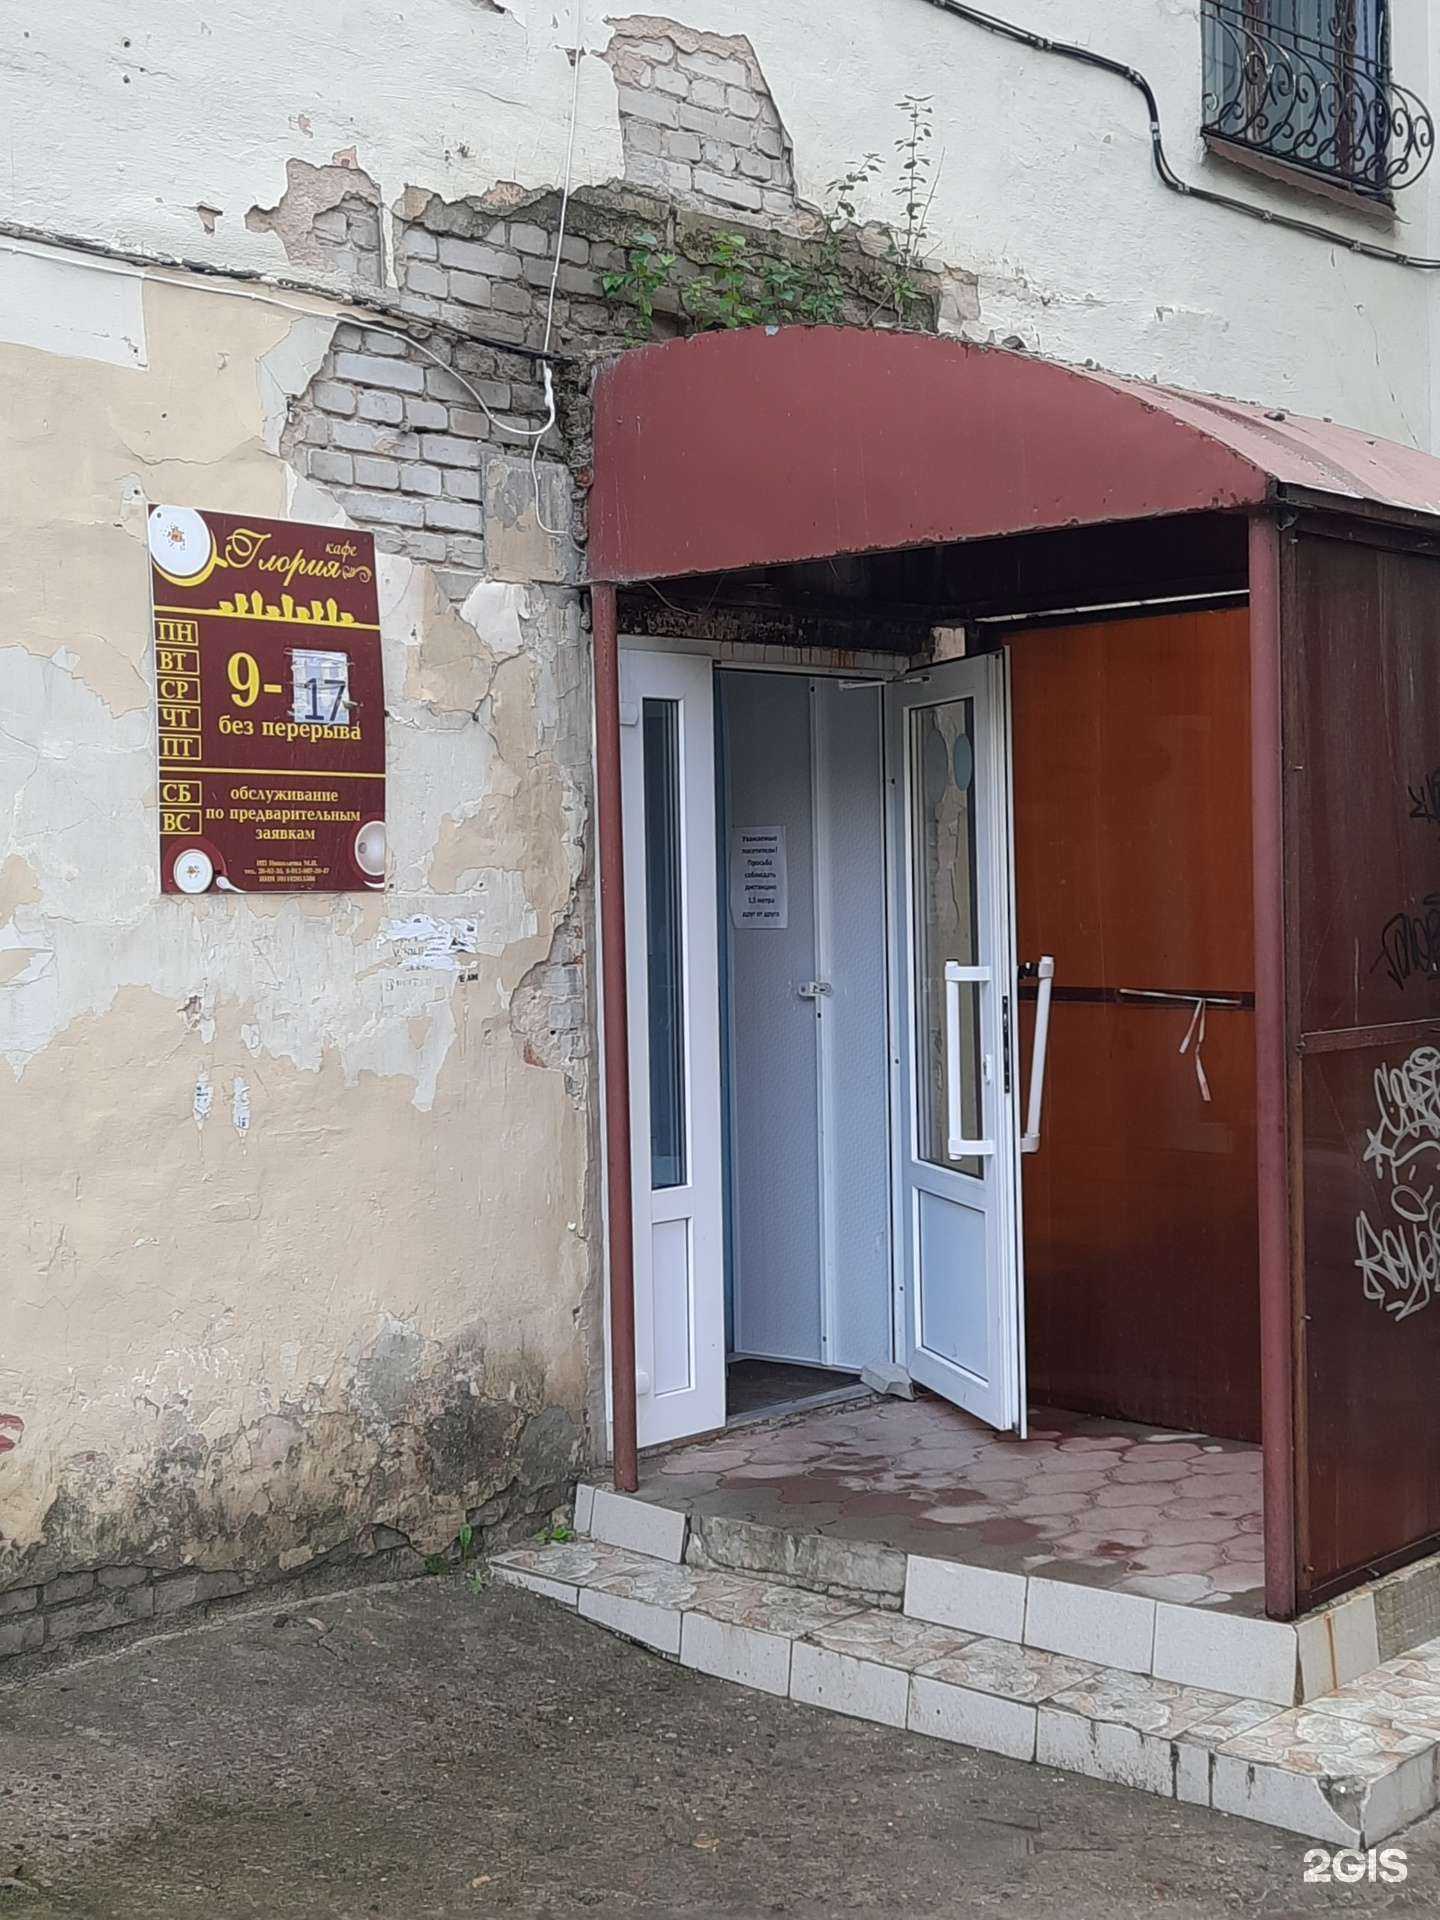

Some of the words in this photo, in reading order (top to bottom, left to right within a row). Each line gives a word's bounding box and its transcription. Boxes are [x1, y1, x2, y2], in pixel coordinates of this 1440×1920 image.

[225, 527, 342, 586] Глория
[325, 540, 358, 563] кафе
[158, 622, 193, 642] ПН
[159, 652, 188, 671] ВТ
[160, 681, 189, 700] СР
[162, 709, 191, 728] ЧТ
[218, 715, 254, 736] без
[262, 720, 362, 744] перерыва
[162, 739, 193, 757] ПТ
[162, 784, 191, 803] СБ
[230, 786, 339, 804] обслуживание
[163, 813, 191, 832] ВС
[206, 808, 224, 820] по
[229, 809, 361, 825] предварительным
[255, 827, 316, 841] заявкам
